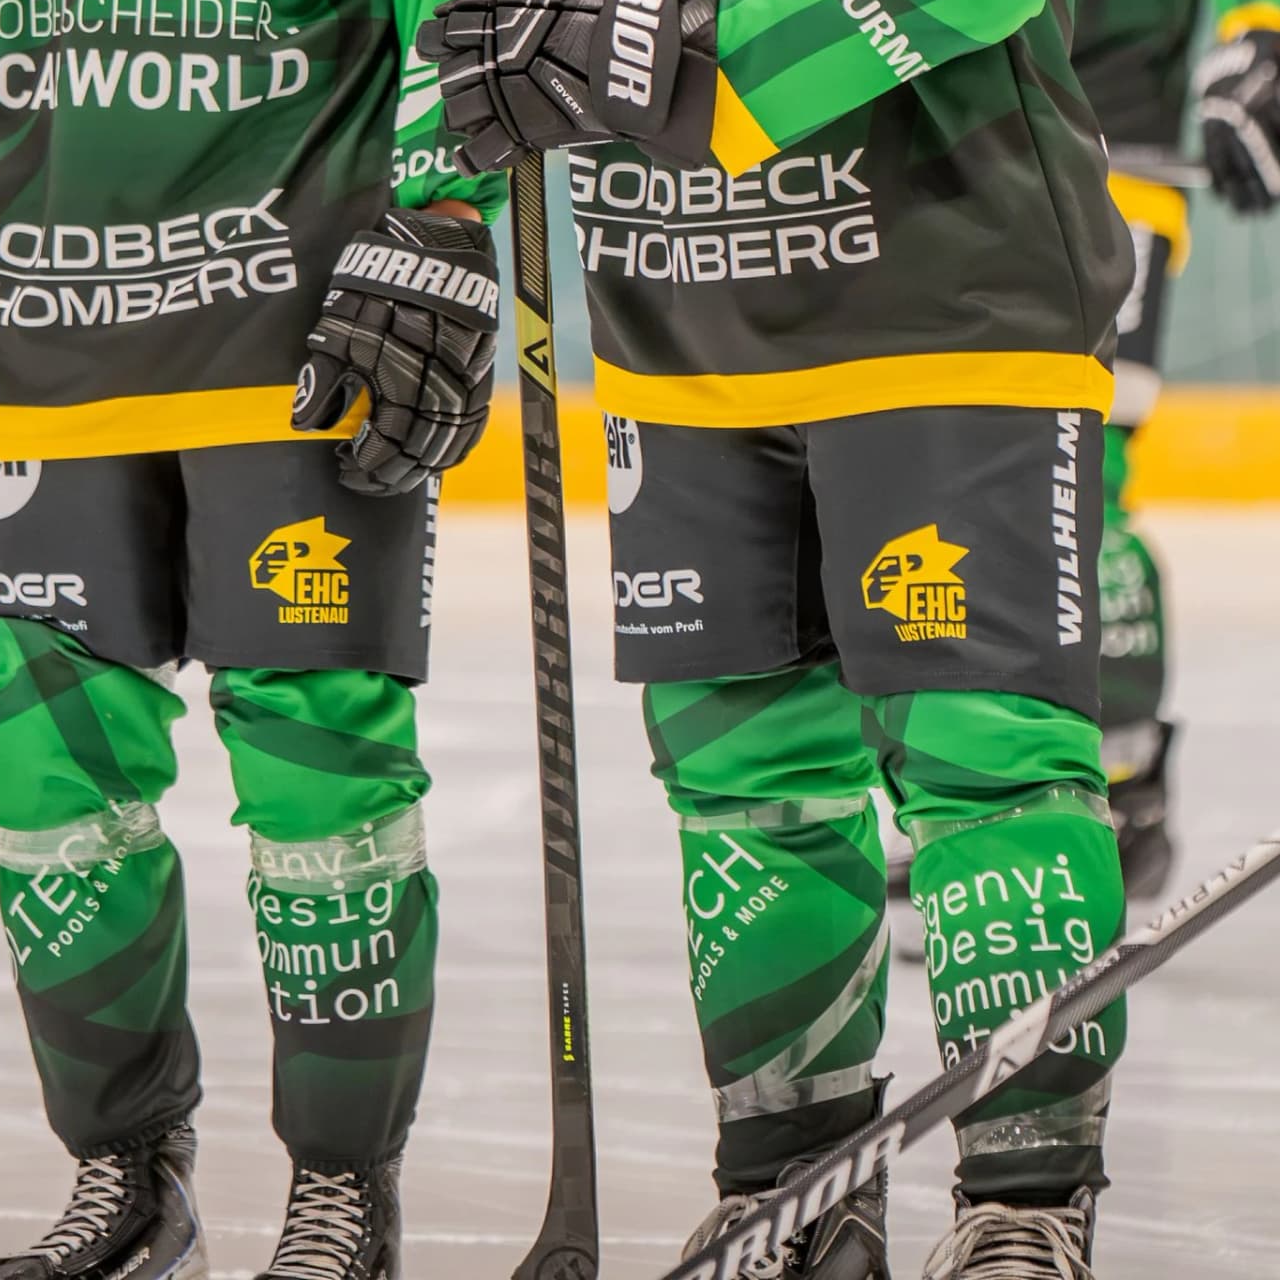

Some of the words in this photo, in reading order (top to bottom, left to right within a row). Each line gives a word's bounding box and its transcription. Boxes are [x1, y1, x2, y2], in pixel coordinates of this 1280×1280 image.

[549, 77, 584, 116] COVERT
[1052, 411, 1083, 646] WILHELM
[297, 572, 349, 605] EHC
[909, 586, 967, 622] EHC
[278, 606, 349, 624] LUSTENAU
[651, 624, 674, 634] vom
[676, 620, 704, 633] Profi
[894, 622, 967, 642] LUSTENAU
[47, 896, 101, 958] POOLS
[694, 941, 725, 1001] POOLS
[734, 875, 789, 925] MORE
[928, 903, 1094, 979] Desig
